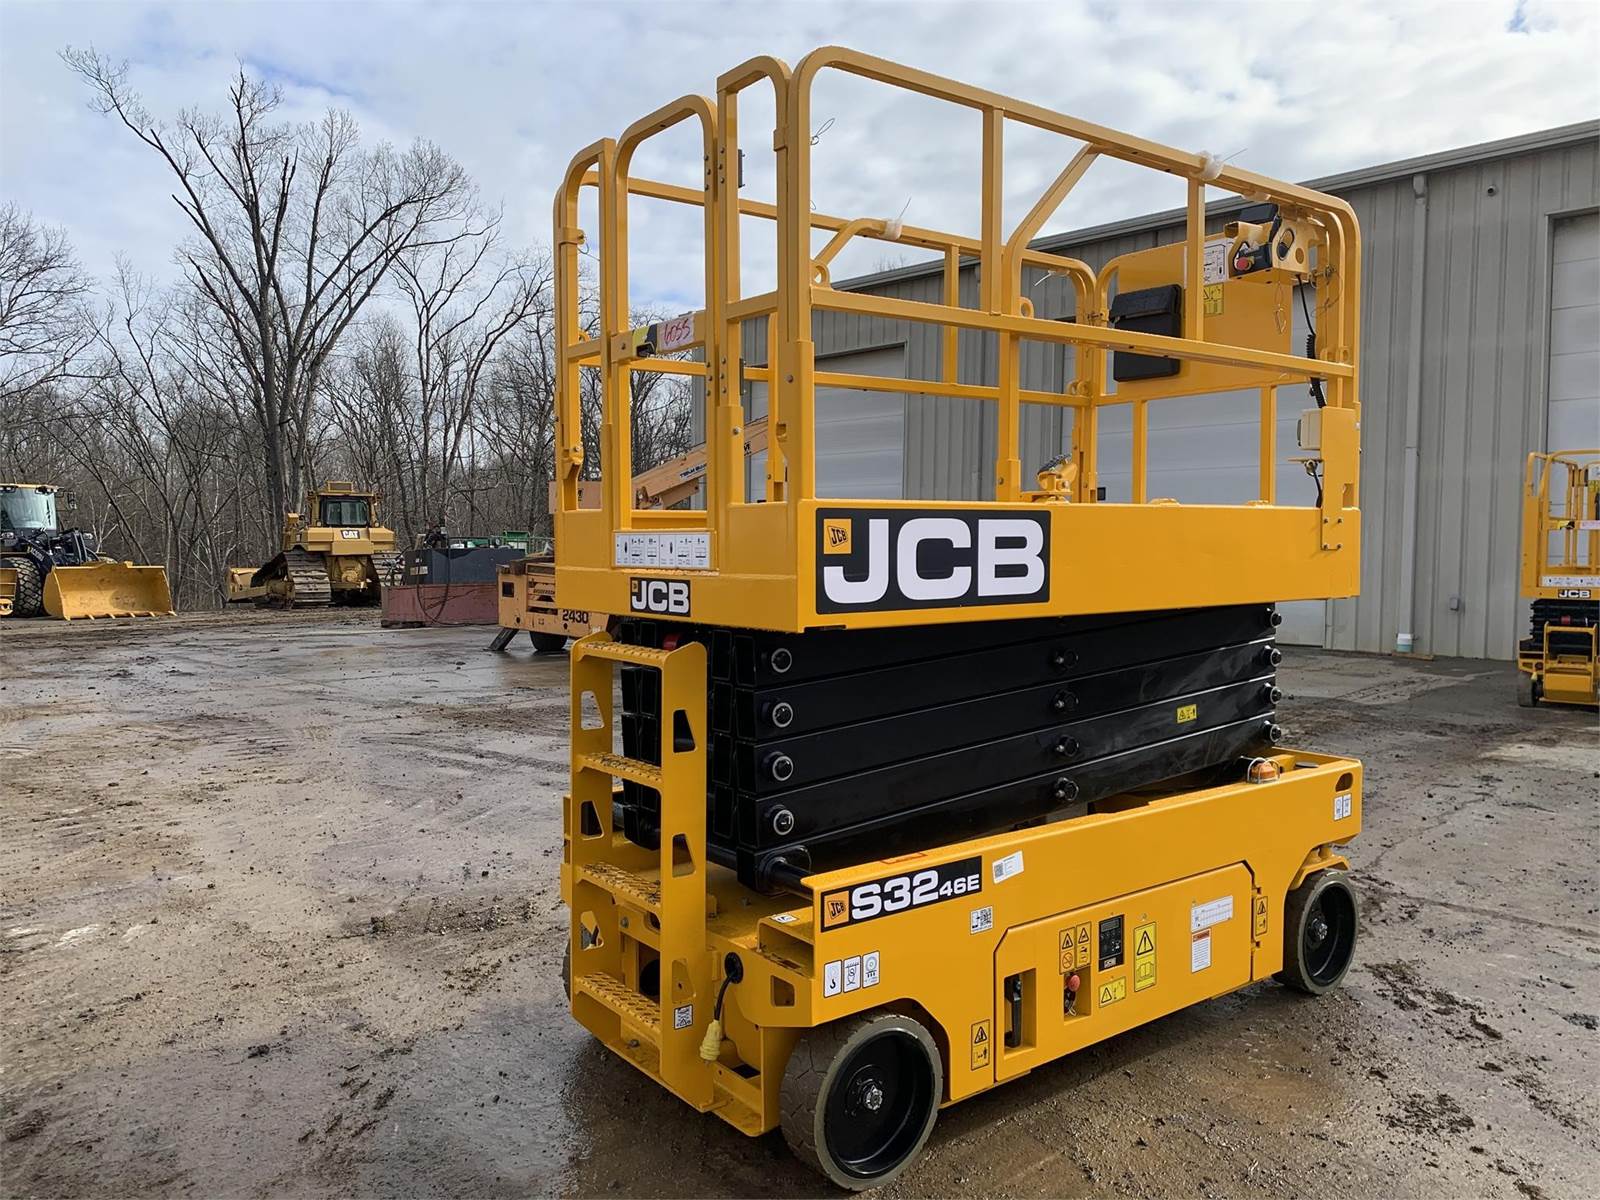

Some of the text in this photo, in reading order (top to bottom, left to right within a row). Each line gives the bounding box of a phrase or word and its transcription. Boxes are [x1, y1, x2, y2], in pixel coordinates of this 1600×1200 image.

[342, 530, 358, 539] CAT
[830, 527, 847, 544] JCB
[824, 518, 1045, 604] JCB
[632, 580, 690, 614] JCB
[1559, 590, 1590, 598] JCB
[562, 609, 589, 624] 2430
[830, 901, 845, 917] JCB
